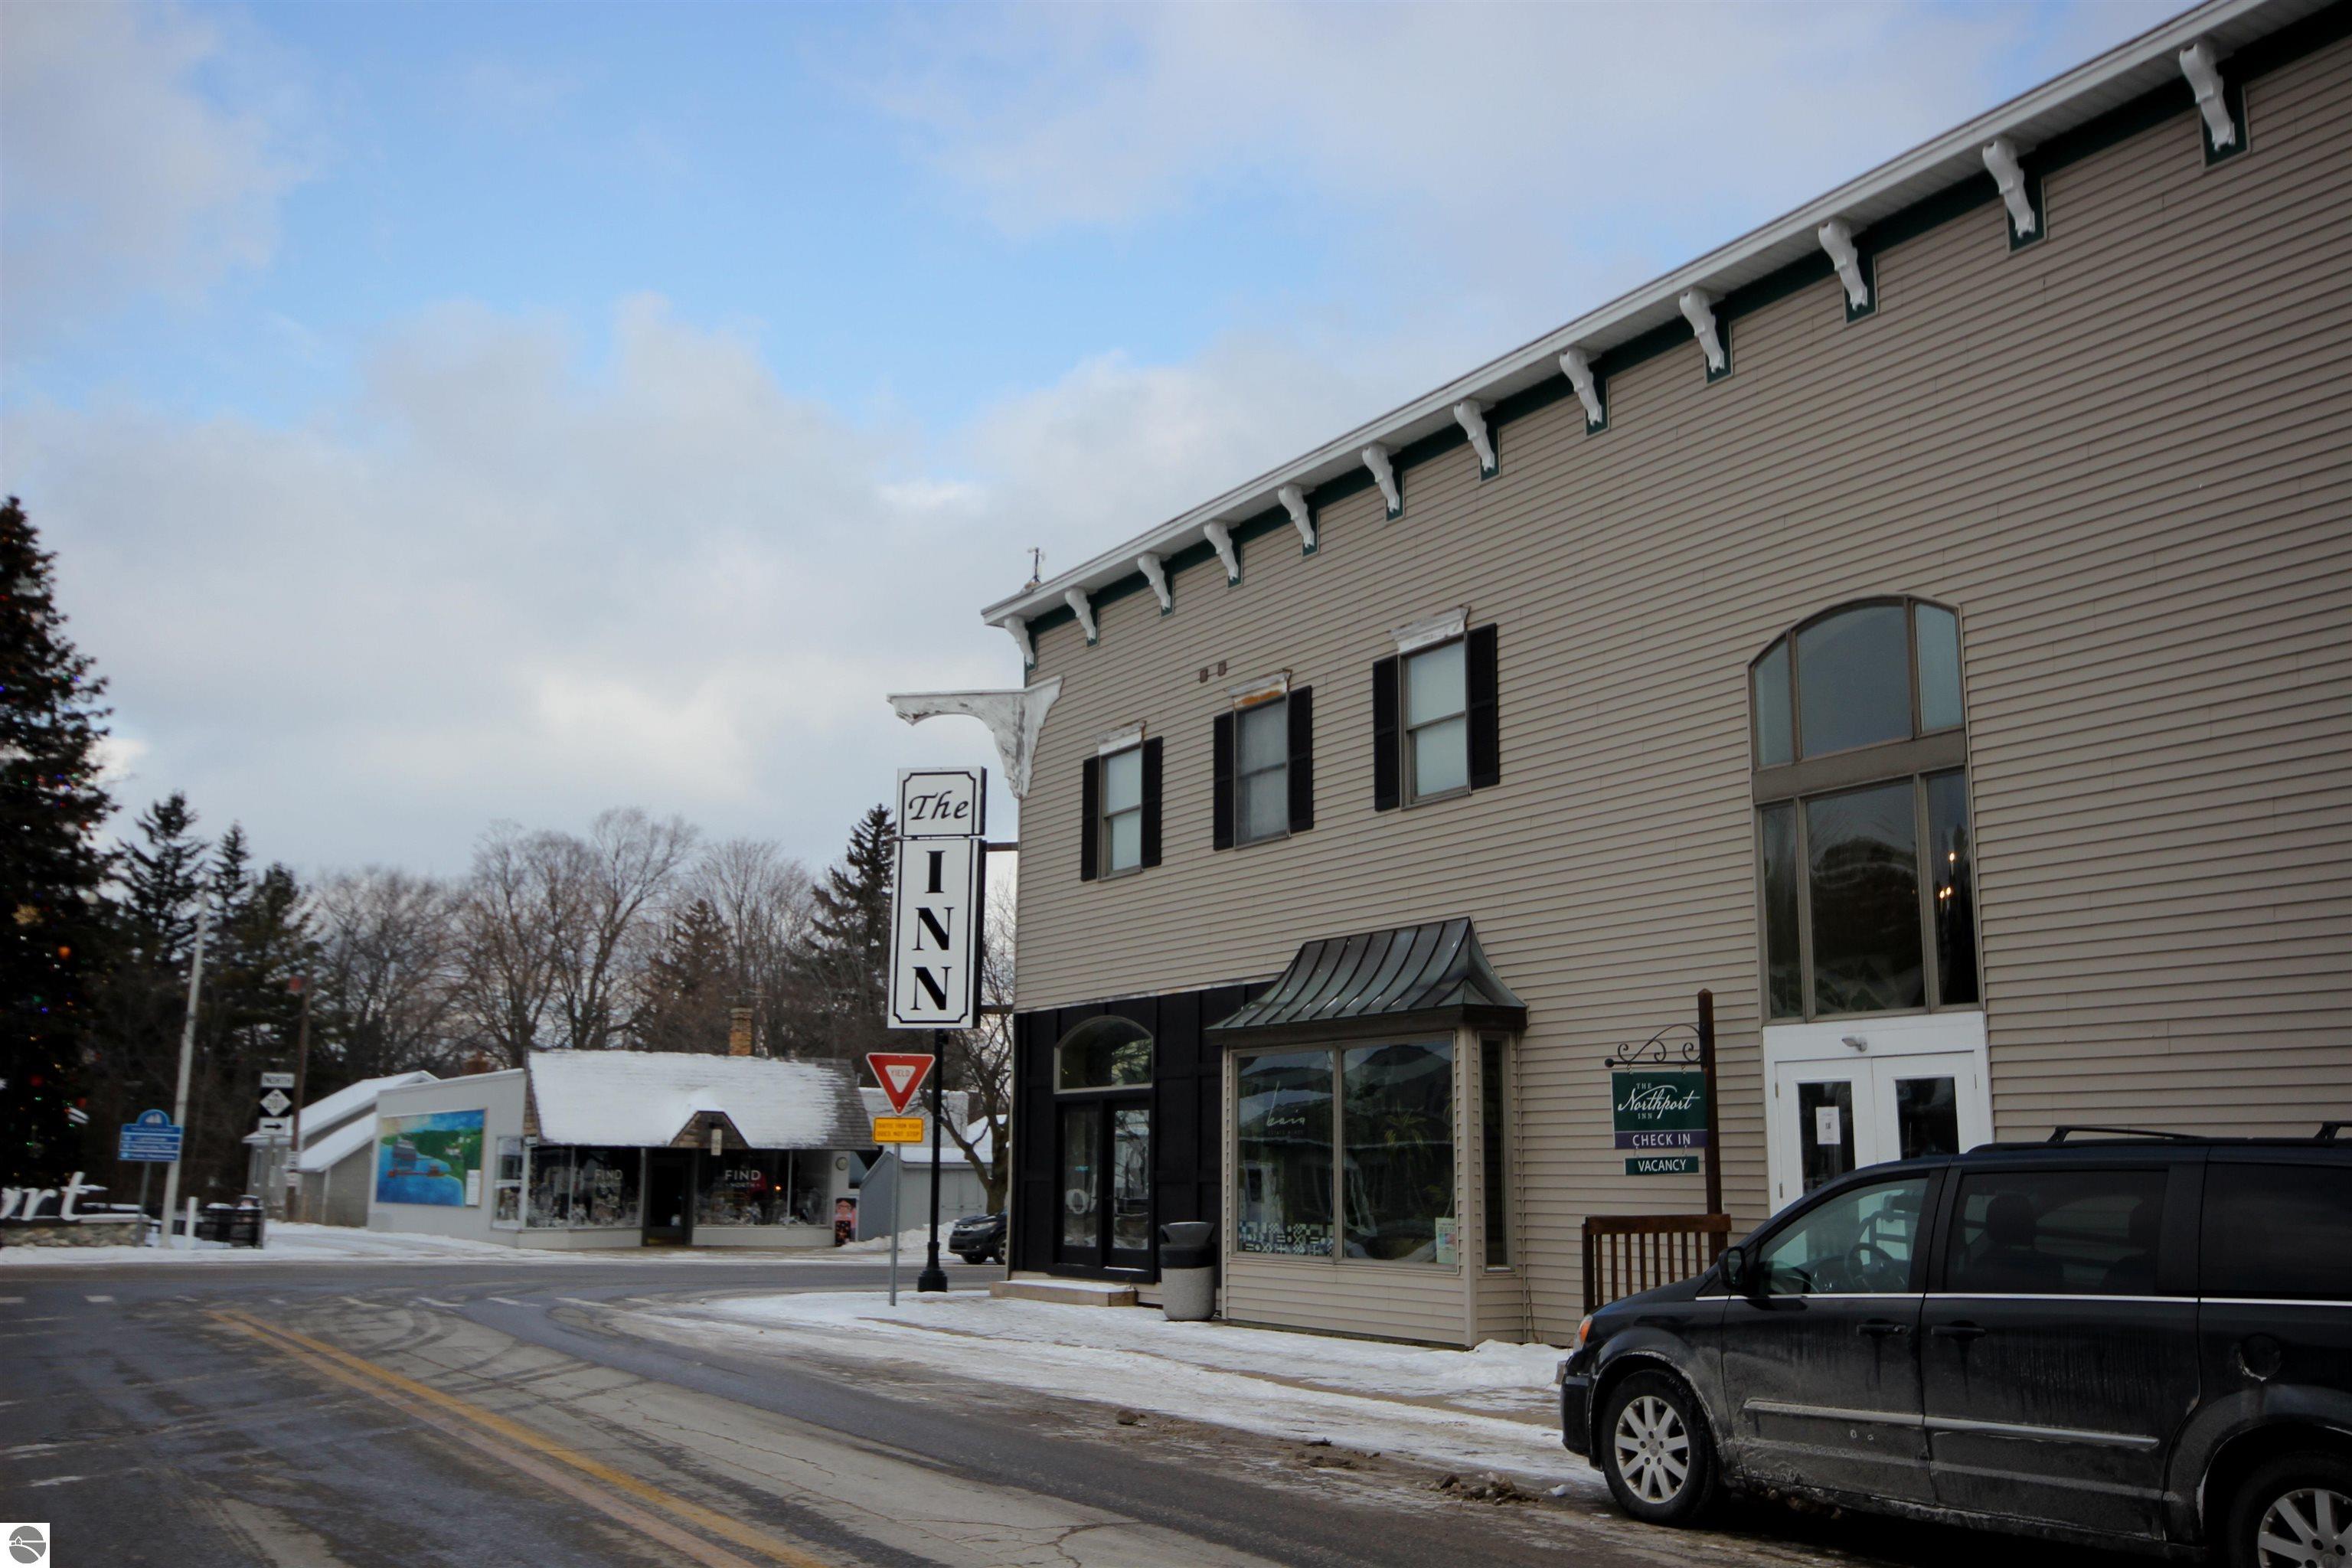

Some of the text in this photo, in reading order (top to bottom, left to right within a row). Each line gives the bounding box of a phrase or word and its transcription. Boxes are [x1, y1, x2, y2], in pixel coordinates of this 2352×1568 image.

[908, 790, 969, 821] The
[910, 850, 955, 1011] INN
[1618, 1085, 1700, 1119] Northport
[1632, 1133, 1691, 1146] CHECK IN
[1637, 1159, 1687, 1172] VACANCY
[594, 1169, 622, 1180] FIND
[724, 1170, 761, 1181] FIND
